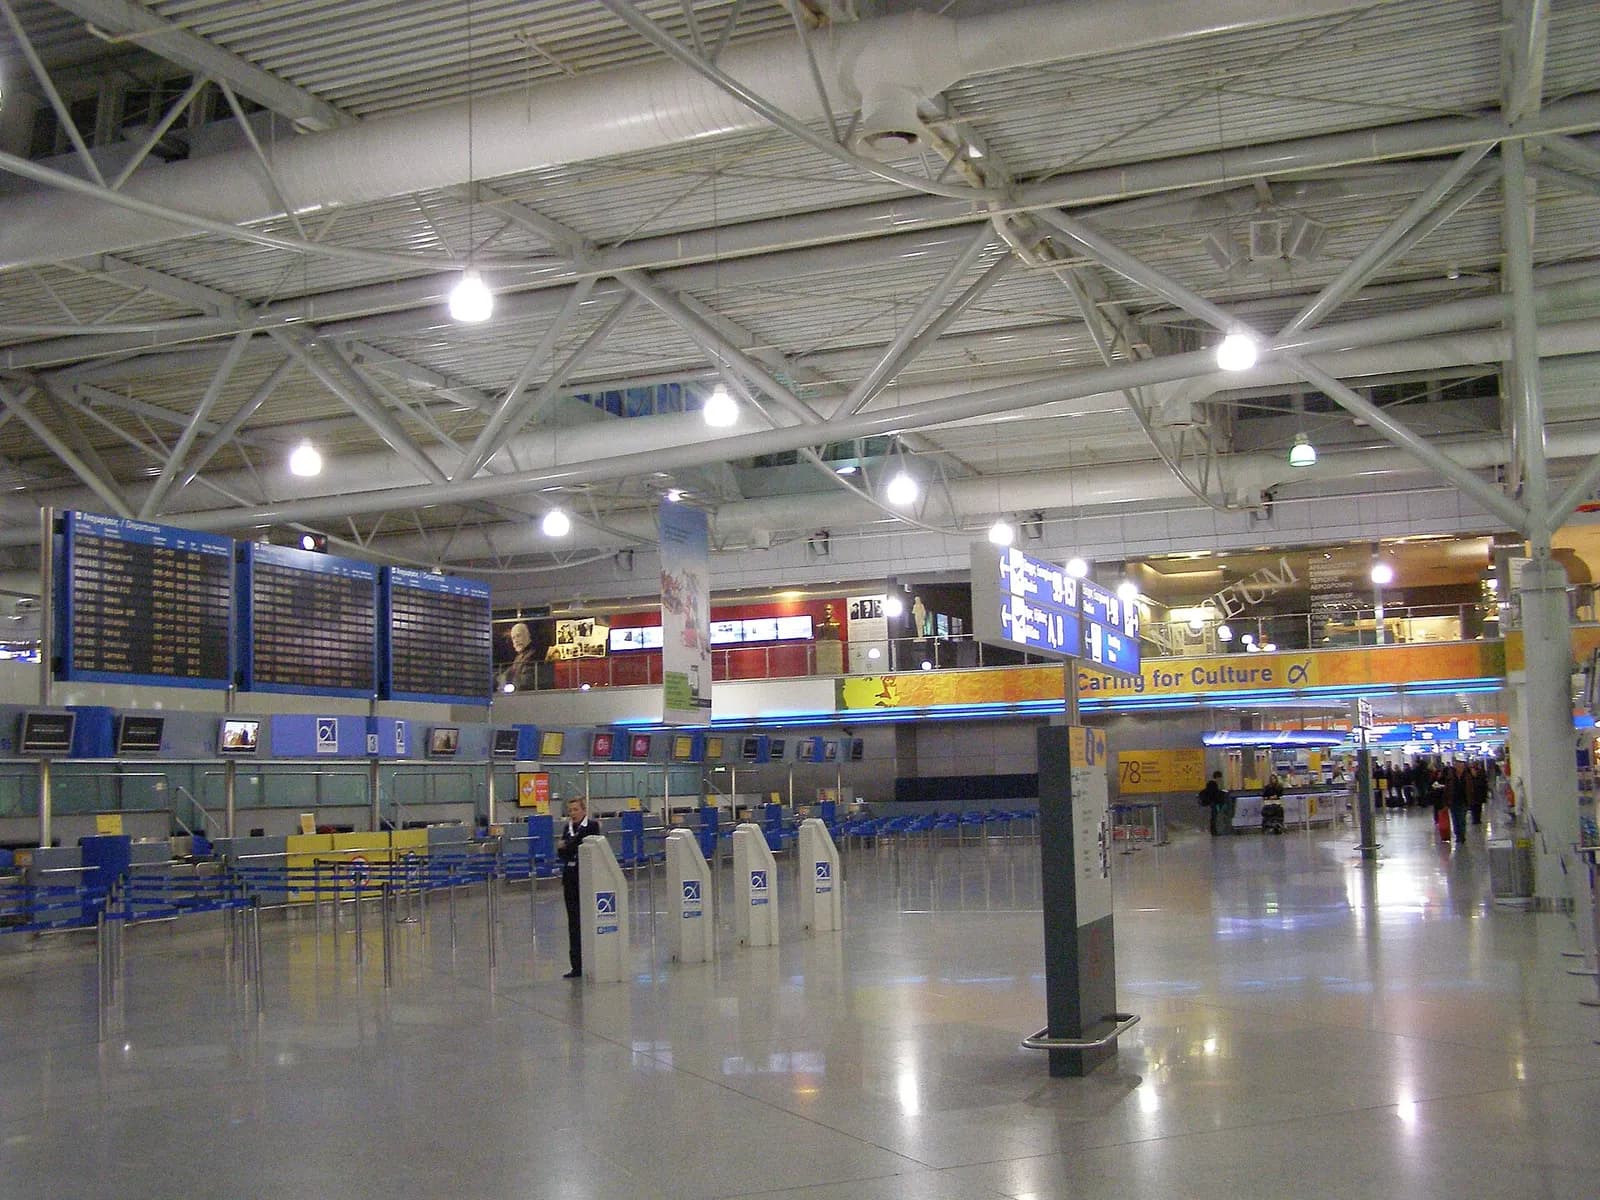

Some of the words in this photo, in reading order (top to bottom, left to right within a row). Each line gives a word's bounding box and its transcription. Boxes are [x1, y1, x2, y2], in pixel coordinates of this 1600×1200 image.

[1078, 673, 1145, 692] Caring
[1153, 669, 1184, 688] for
[1192, 665, 1273, 685] Culture
[1119, 760, 1141, 785] 78
